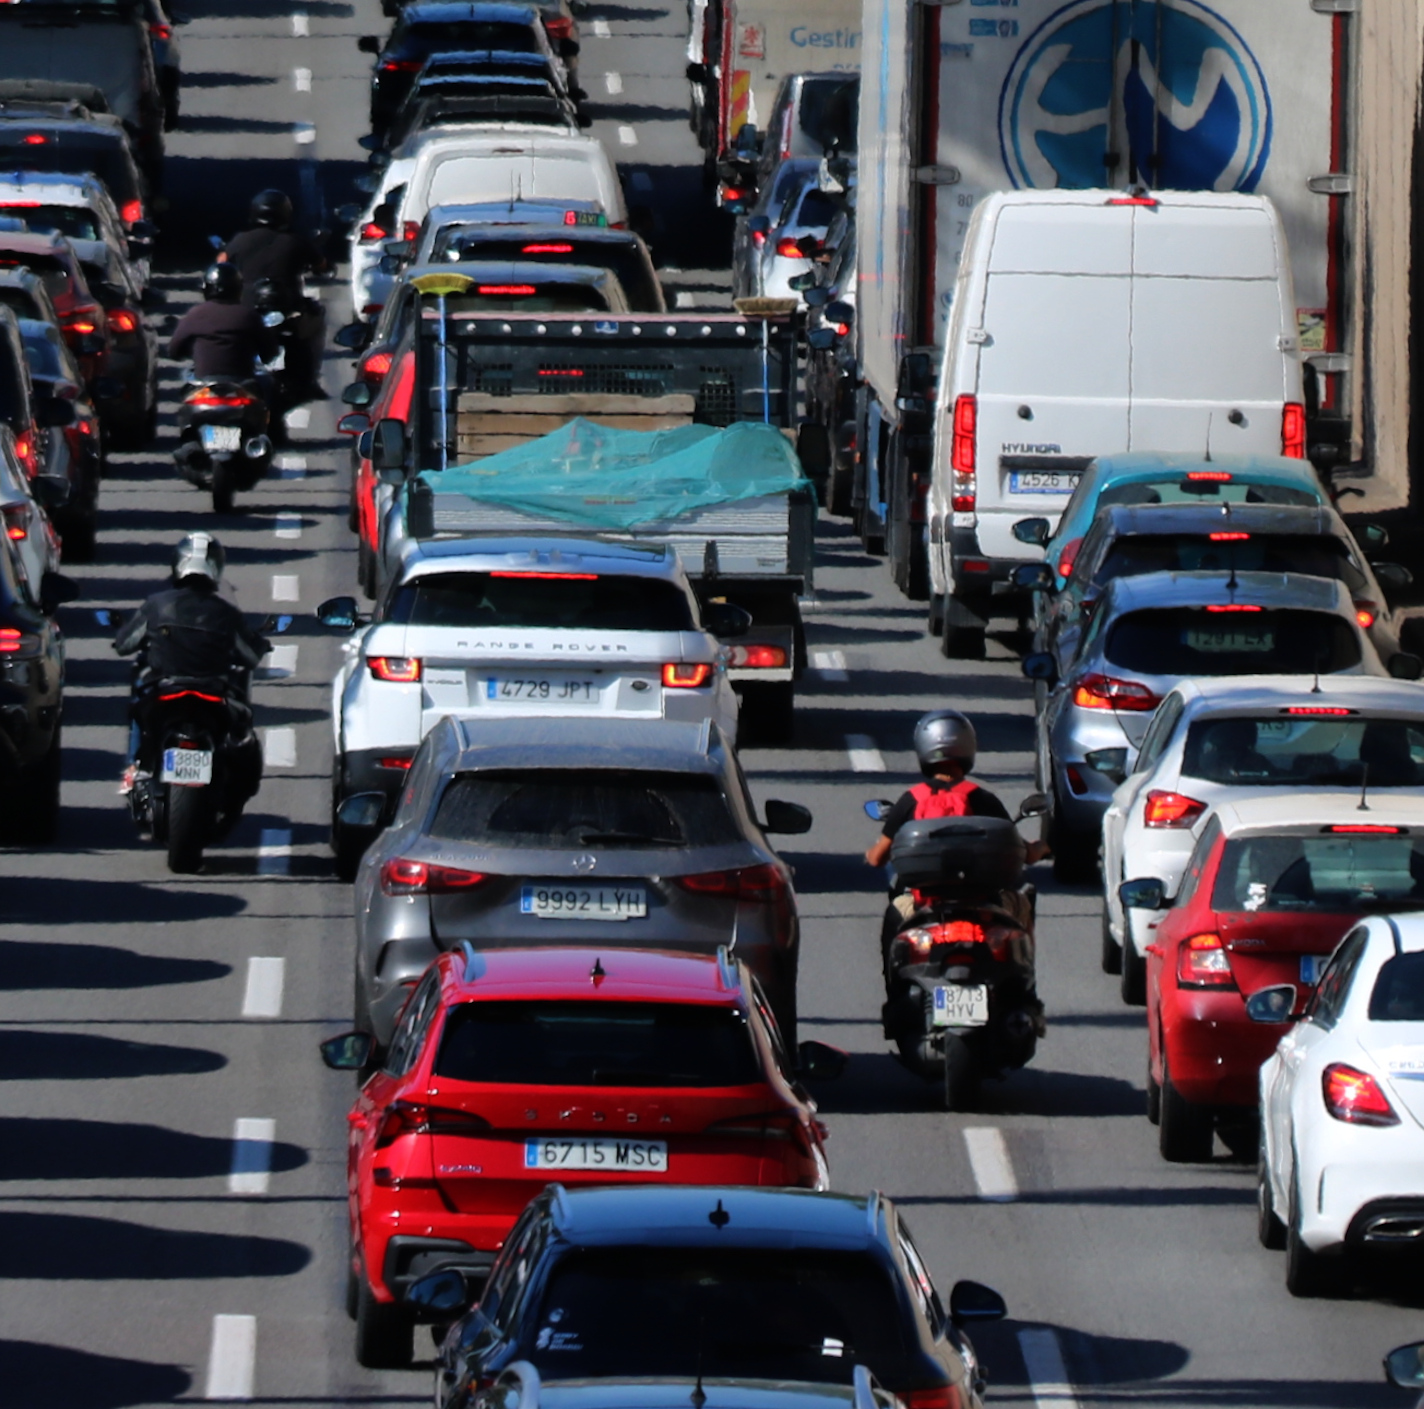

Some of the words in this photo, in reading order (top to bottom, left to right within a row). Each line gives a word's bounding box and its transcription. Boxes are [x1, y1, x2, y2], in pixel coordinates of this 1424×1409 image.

[957, 194, 973, 207] 80
[1001, 443, 1062, 453] HYUNDAI
[1021, 472, 1061, 487] 4526
[456, 641, 535, 650] RANGE
[552, 643, 628, 652] ROVER
[500, 679, 551, 699] 4729
[558, 680, 595, 700] JPT
[175, 751, 210, 767] 3890
[536, 890, 592, 912] 9992
[598, 890, 641, 913] LYH
[946, 988, 984, 1003] 8713
[946, 1003, 975, 1018] HYV
[543, 1142, 606, 1164] 6715
[615, 1143, 662, 1166] MSC
